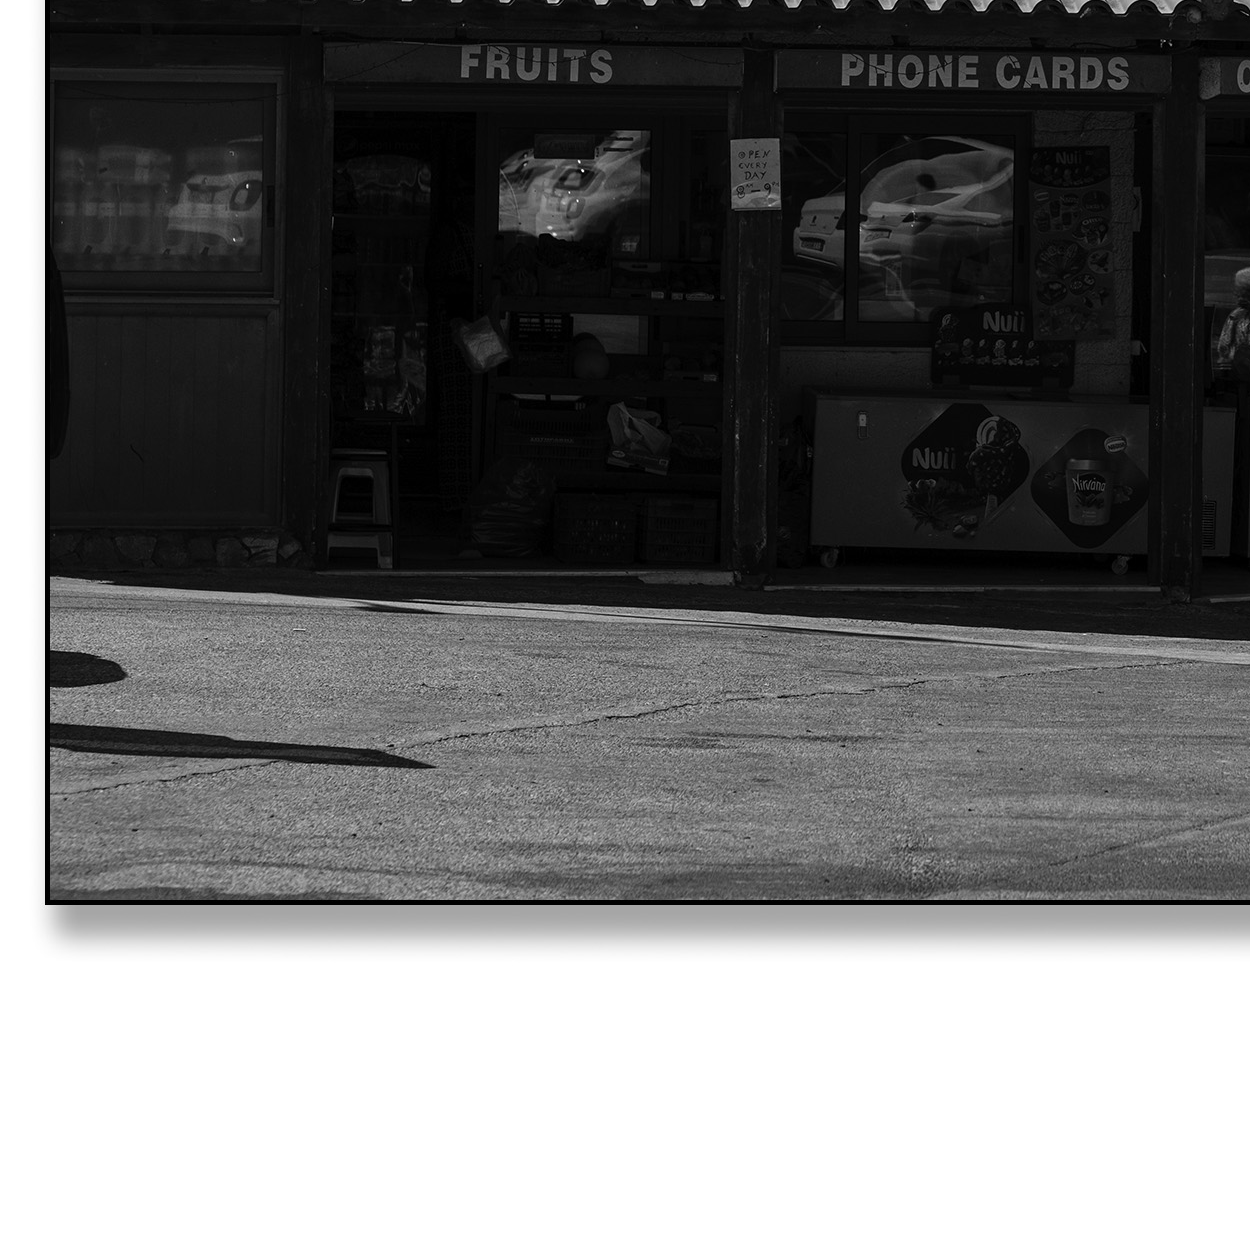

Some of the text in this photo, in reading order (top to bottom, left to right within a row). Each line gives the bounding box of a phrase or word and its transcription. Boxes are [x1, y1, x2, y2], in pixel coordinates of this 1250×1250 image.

[460, 45, 613, 84] FRUITS
[841, 53, 1130, 91] PHONE CARDS
[738, 150, 771, 159] OPEN
[744, 171, 767, 180] DAY
[982, 310, 1025, 333] Nuii
[912, 447, 957, 470] Nuii
